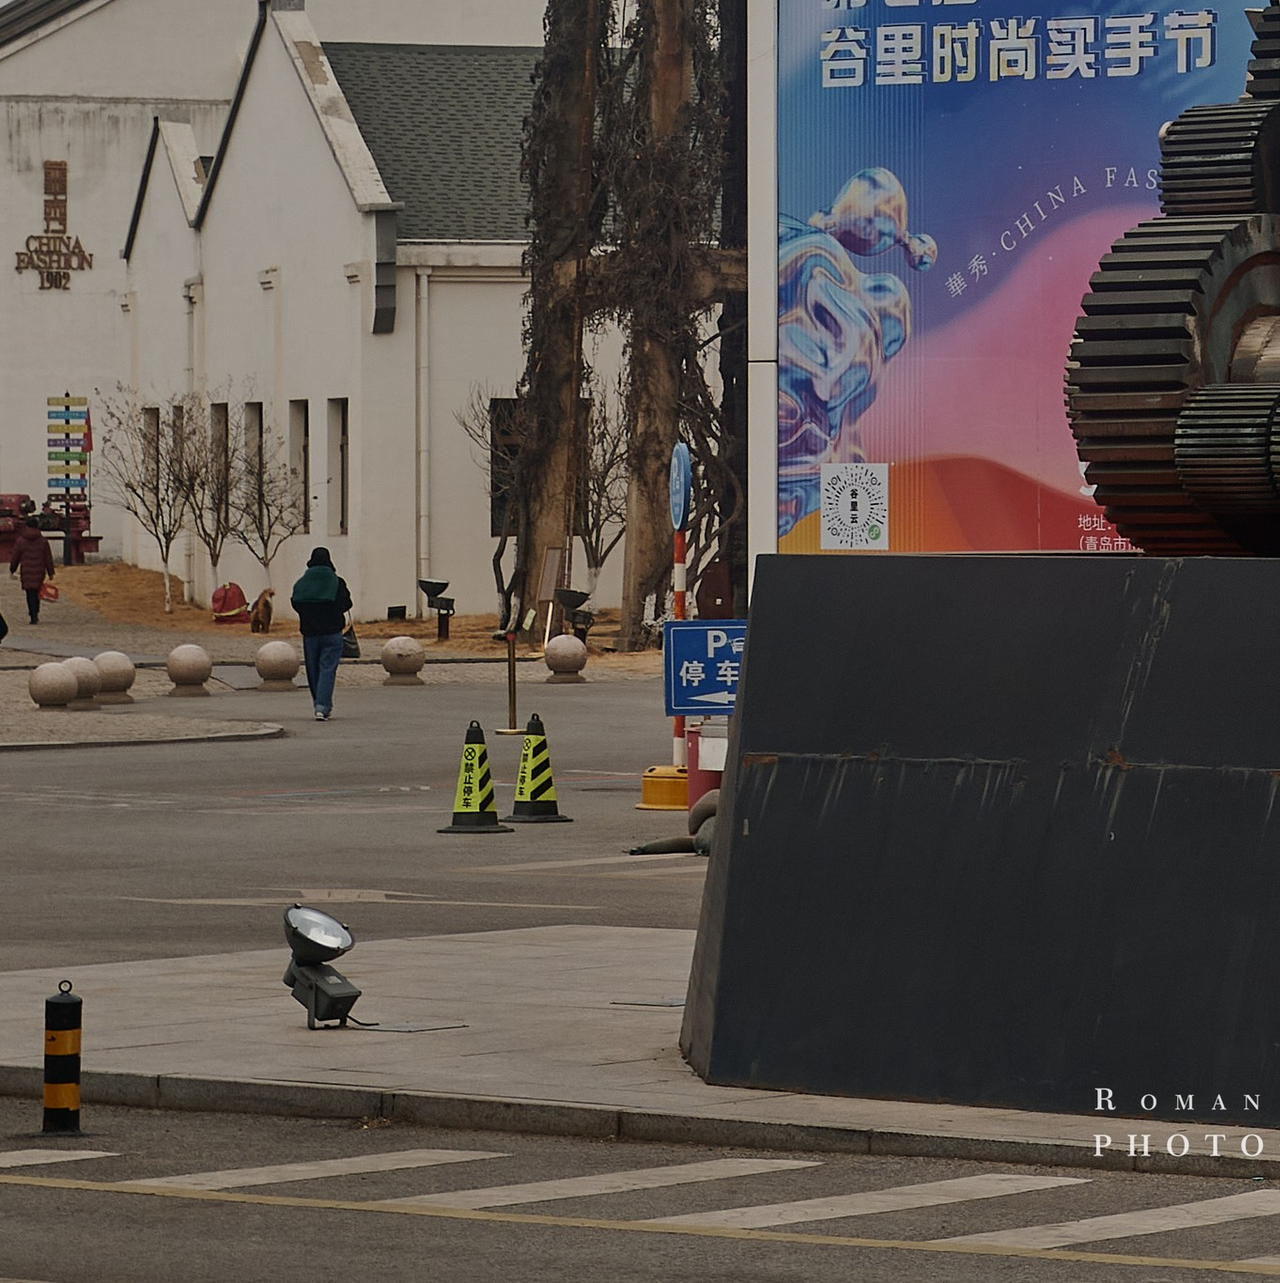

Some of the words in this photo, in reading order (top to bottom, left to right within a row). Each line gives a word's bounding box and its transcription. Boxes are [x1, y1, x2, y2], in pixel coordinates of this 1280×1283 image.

[820, 9, 1219, 90] 谷里时尚买手节
[1104, 167, 1159, 190] FAS
[26, 235, 85, 254] CHINA
[15, 251, 94, 271] FASHION
[38, 270, 71, 290] 1902
[707, 630, 728, 658] P
[679, 660, 740, 687] 停车
[462, 762, 474, 809] 禁止停车
